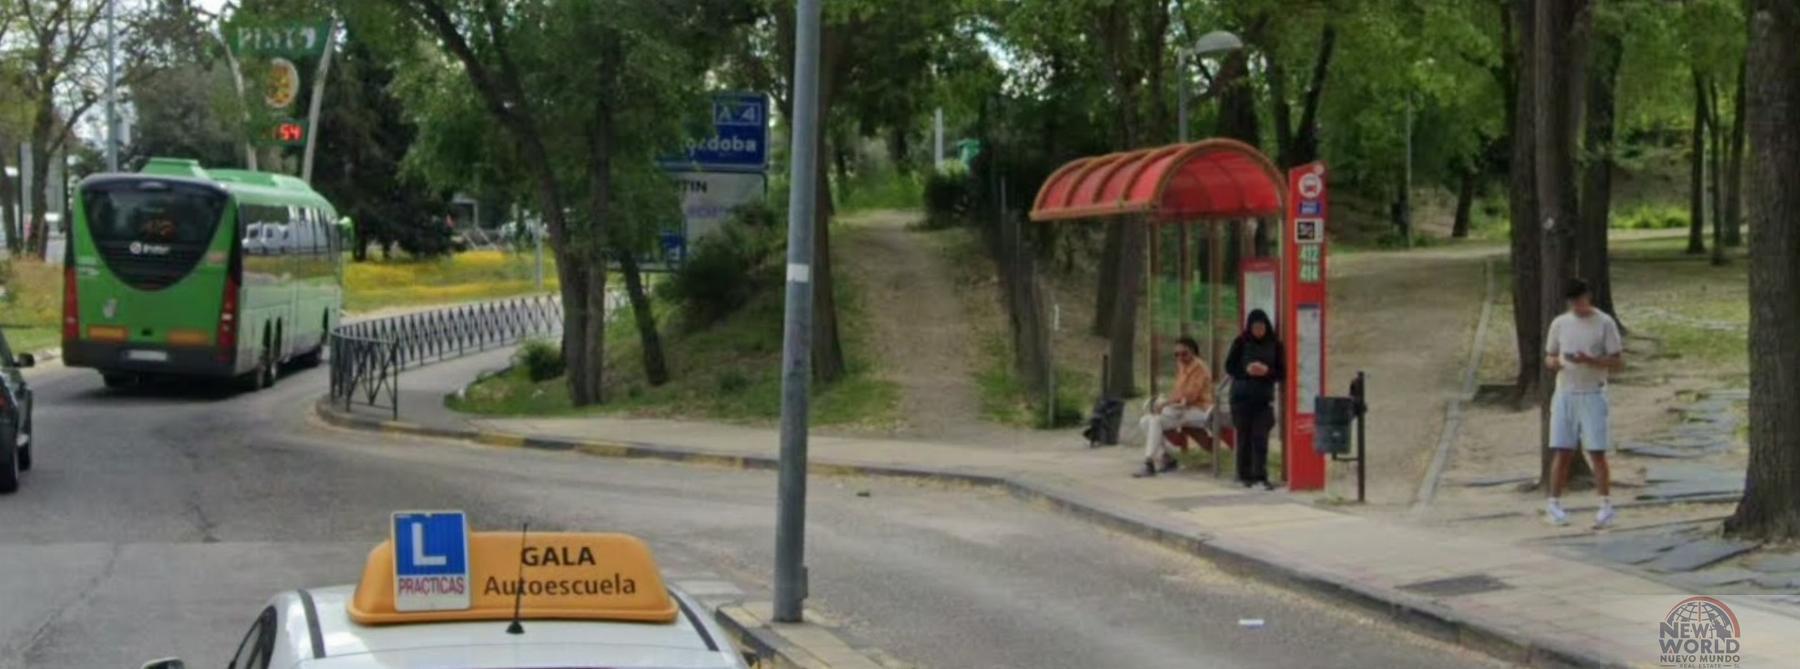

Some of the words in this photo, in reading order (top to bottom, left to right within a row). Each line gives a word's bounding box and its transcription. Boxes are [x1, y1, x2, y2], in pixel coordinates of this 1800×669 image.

[685, 136, 756, 152] ordoba
[411, 522, 447, 566] L
[521, 547, 596, 567] GALA
[484, 573, 636, 596] Autoescuela
